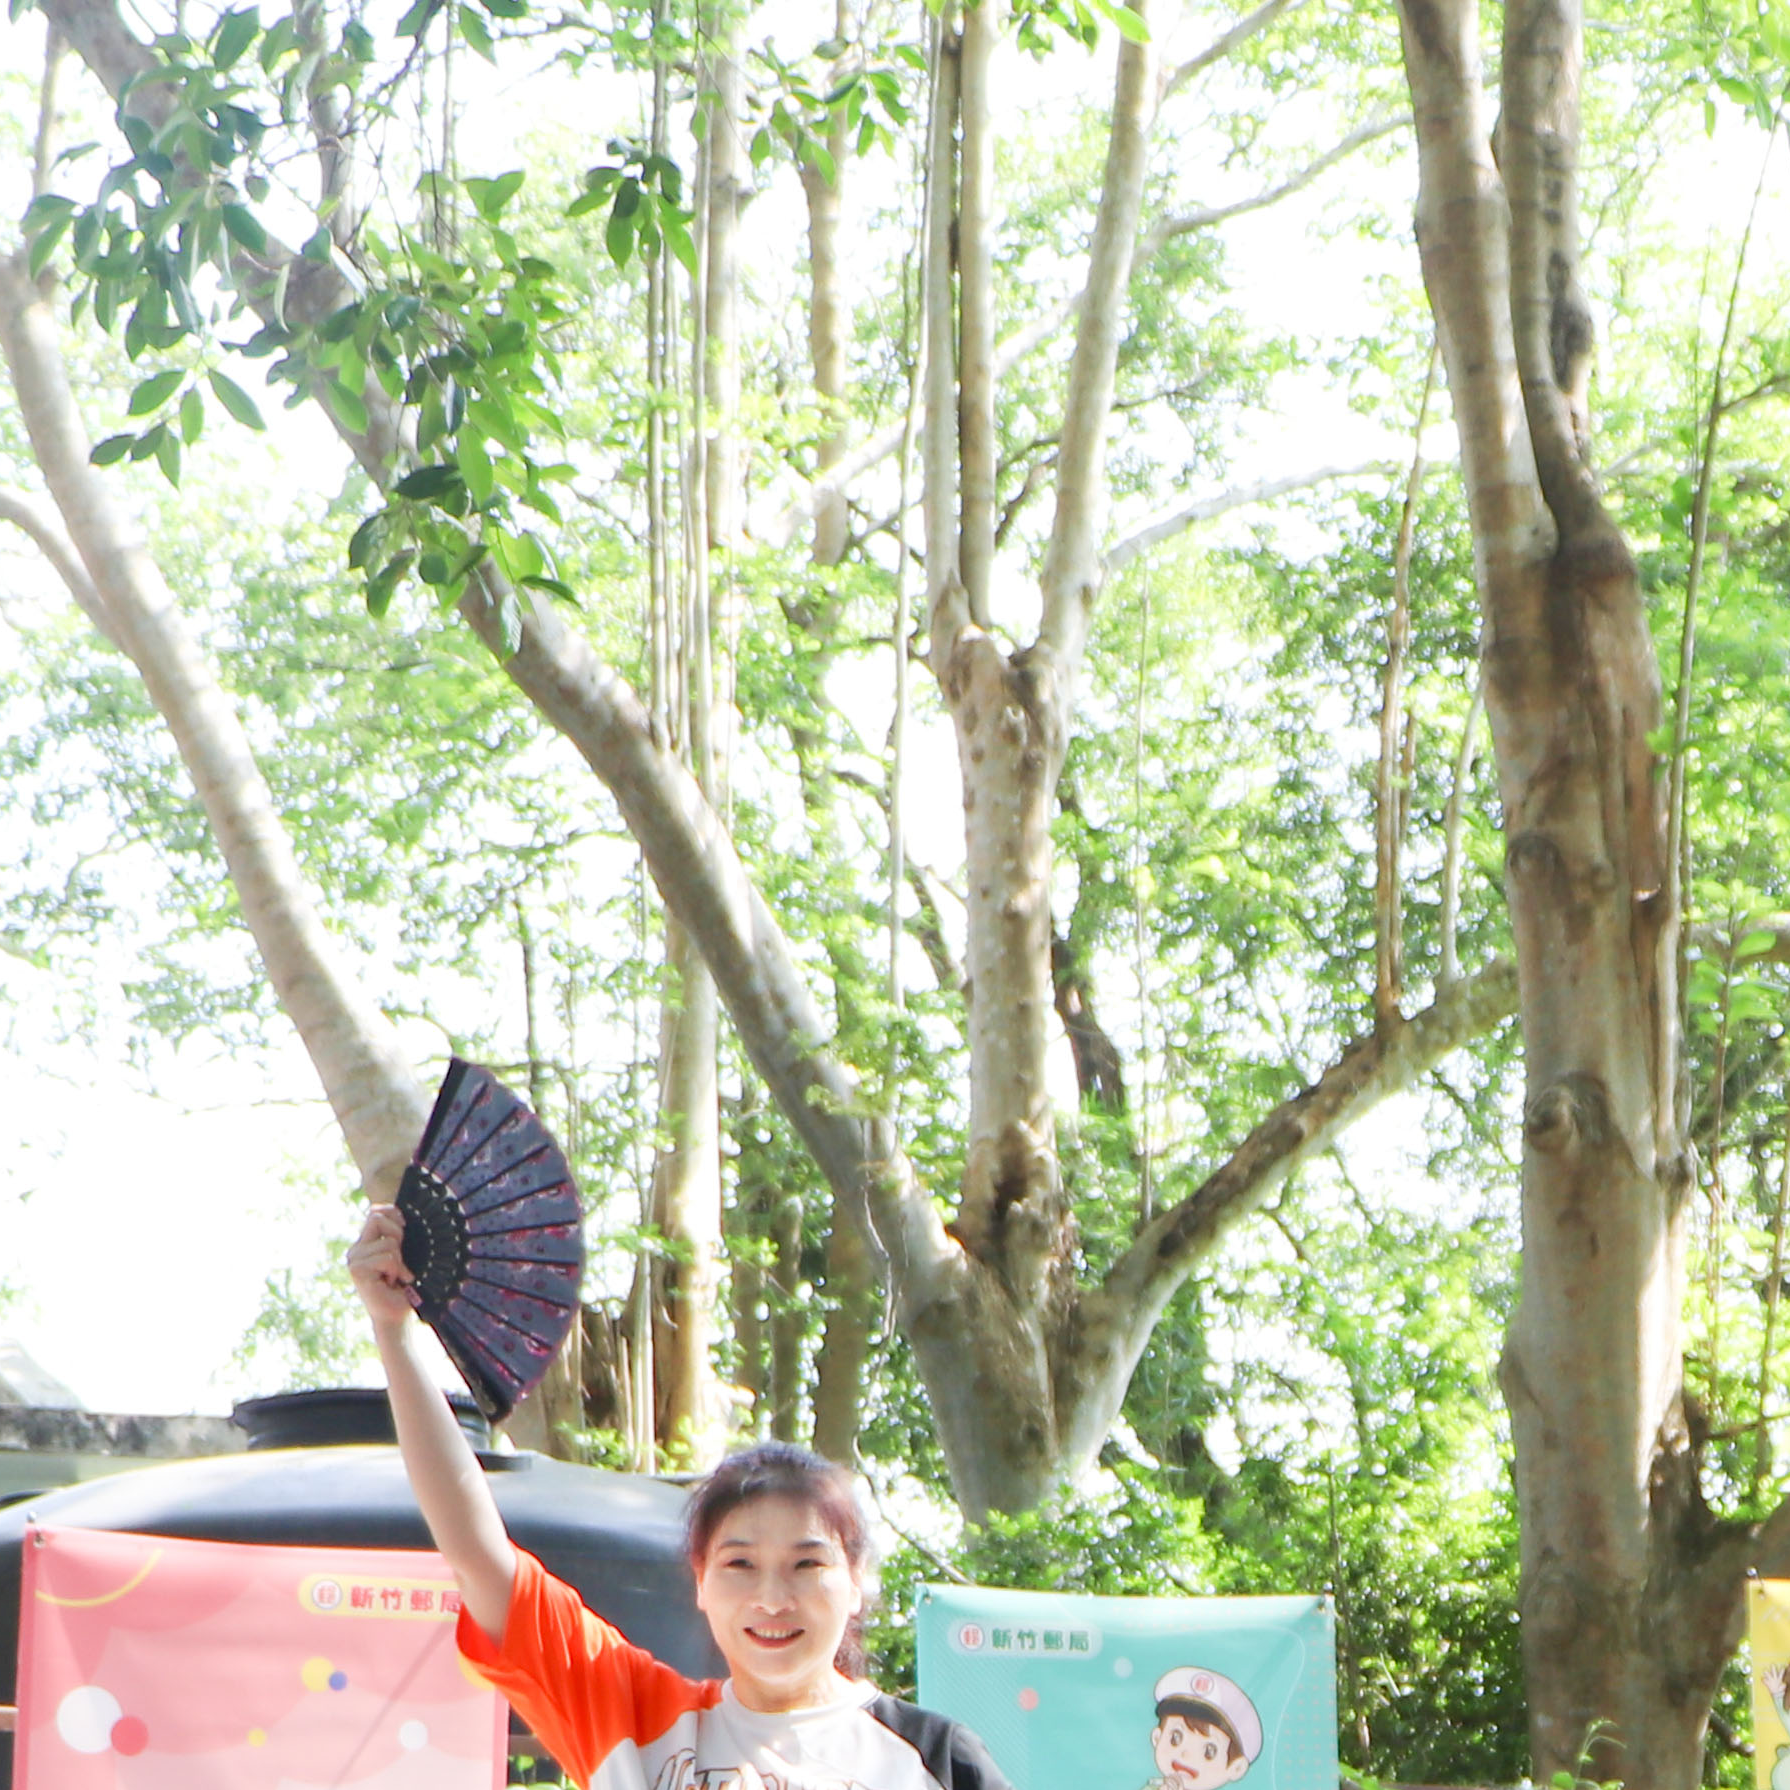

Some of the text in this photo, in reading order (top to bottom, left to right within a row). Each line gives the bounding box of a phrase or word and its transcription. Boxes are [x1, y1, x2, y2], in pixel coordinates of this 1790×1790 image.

[349, 1585, 461, 1614] 新竹郵局
[991, 1627, 1090, 1652] 新竹郵局
